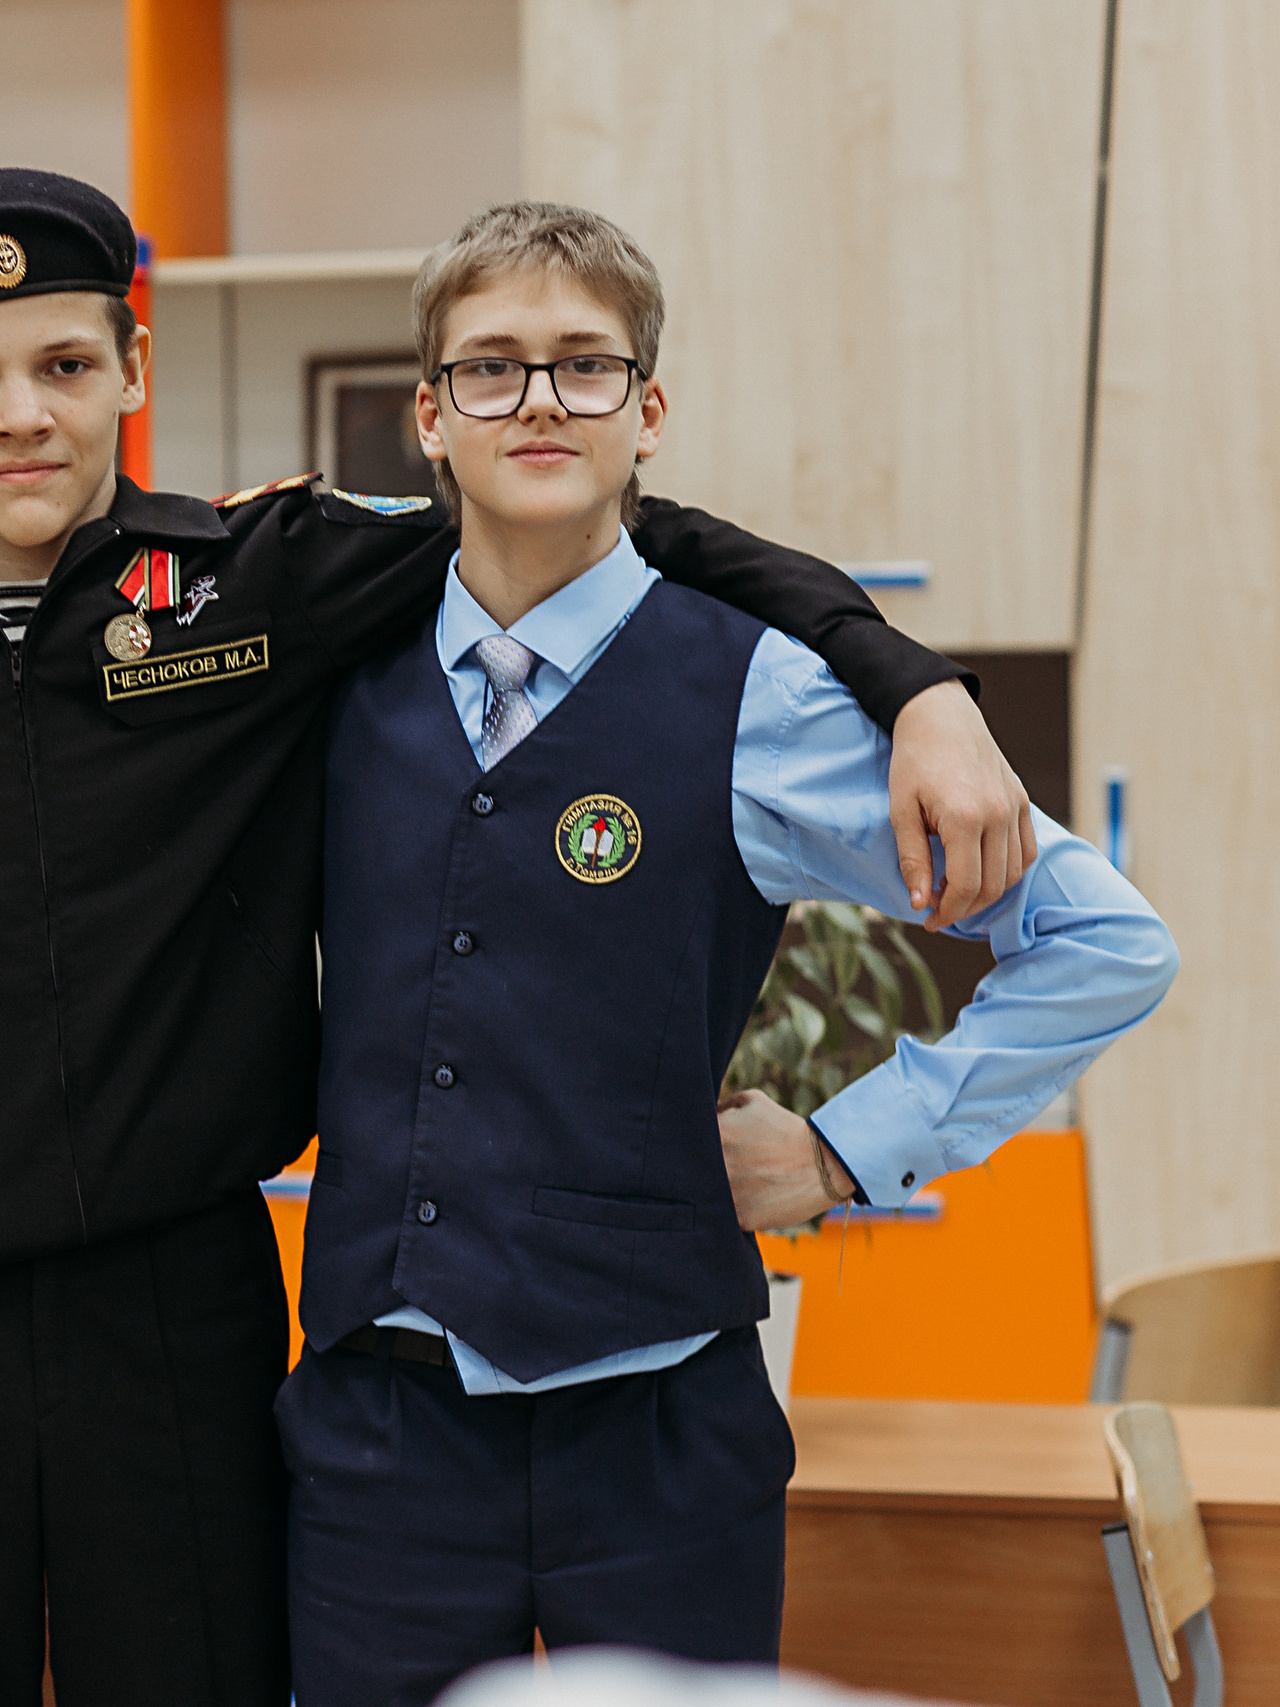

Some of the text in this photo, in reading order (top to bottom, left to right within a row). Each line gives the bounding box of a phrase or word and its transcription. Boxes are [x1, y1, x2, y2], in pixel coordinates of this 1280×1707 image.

[113, 646, 262, 689] ЧЕСНОКОВ М.А.
[562, 799, 623, 833] ГИМНАЗИЯ
